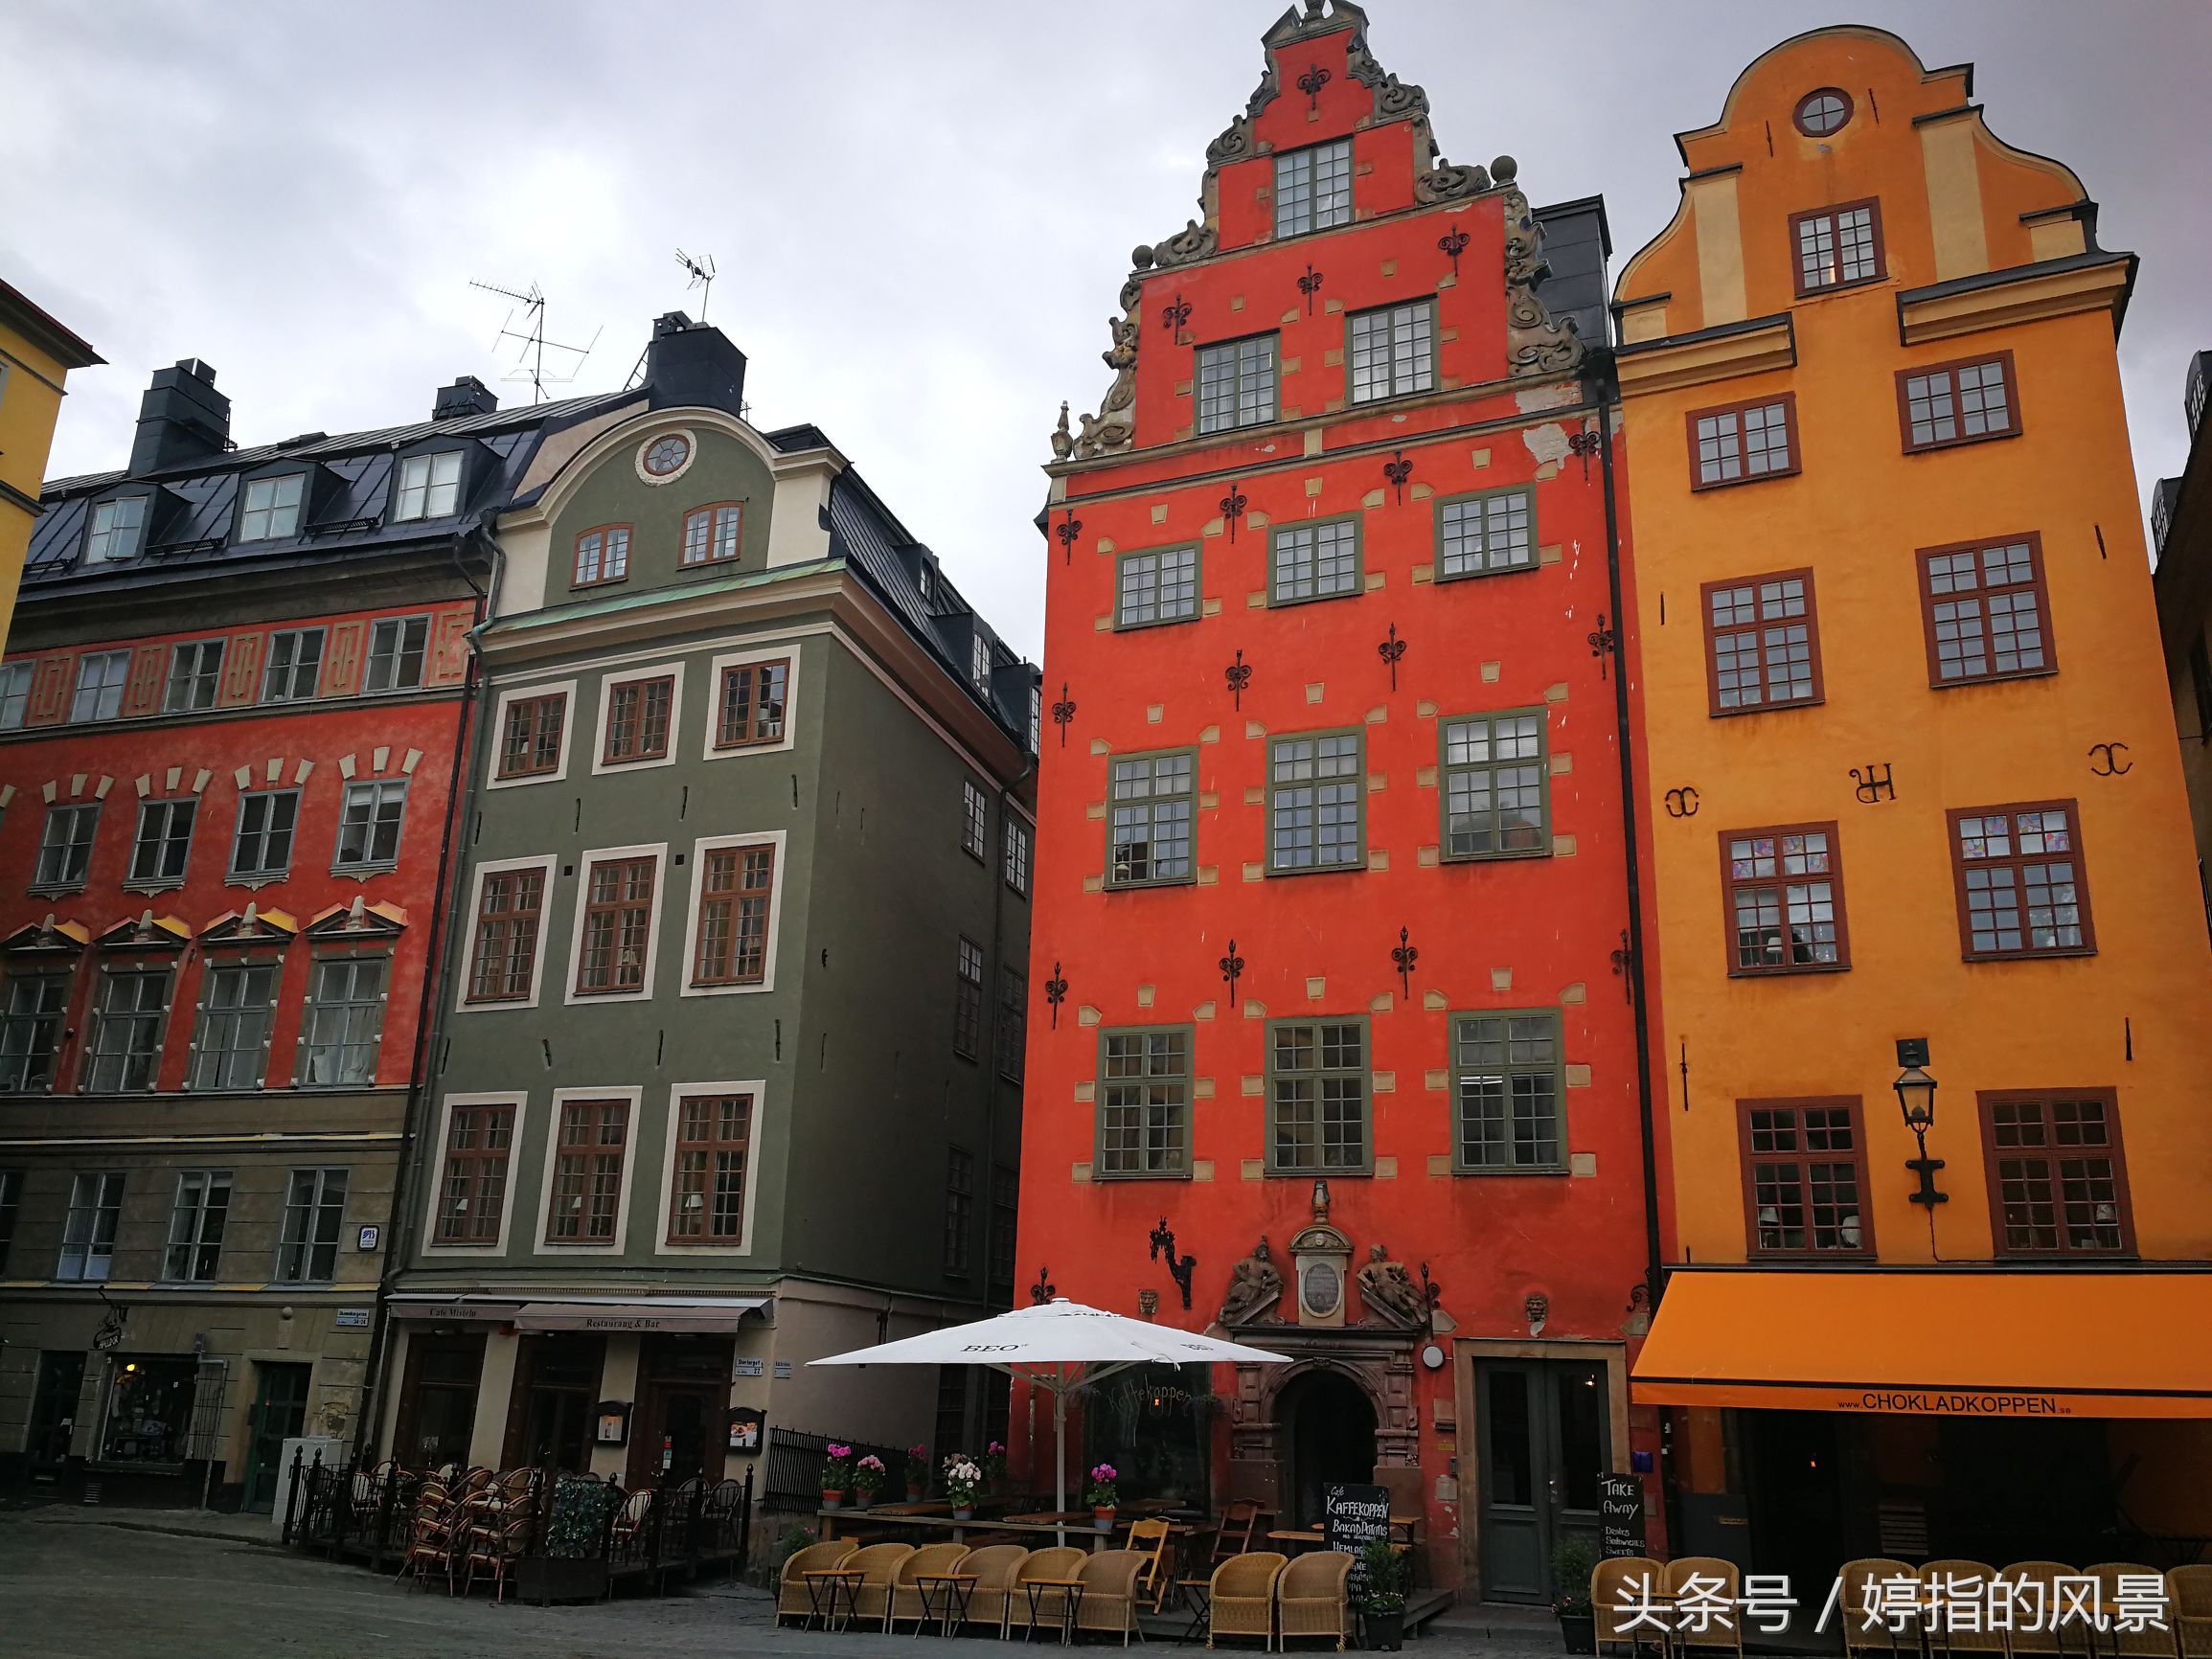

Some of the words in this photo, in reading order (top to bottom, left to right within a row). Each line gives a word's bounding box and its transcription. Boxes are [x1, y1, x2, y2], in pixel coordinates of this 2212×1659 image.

[586, 1318, 632, 1329] Restaurang
[634, 1320, 641, 1329] &
[645, 1319, 660, 1329] Bar
[1601, 1478, 1635, 1497] TAKE
[1326, 1495, 1389, 1519] KAFFEKOPPEN
